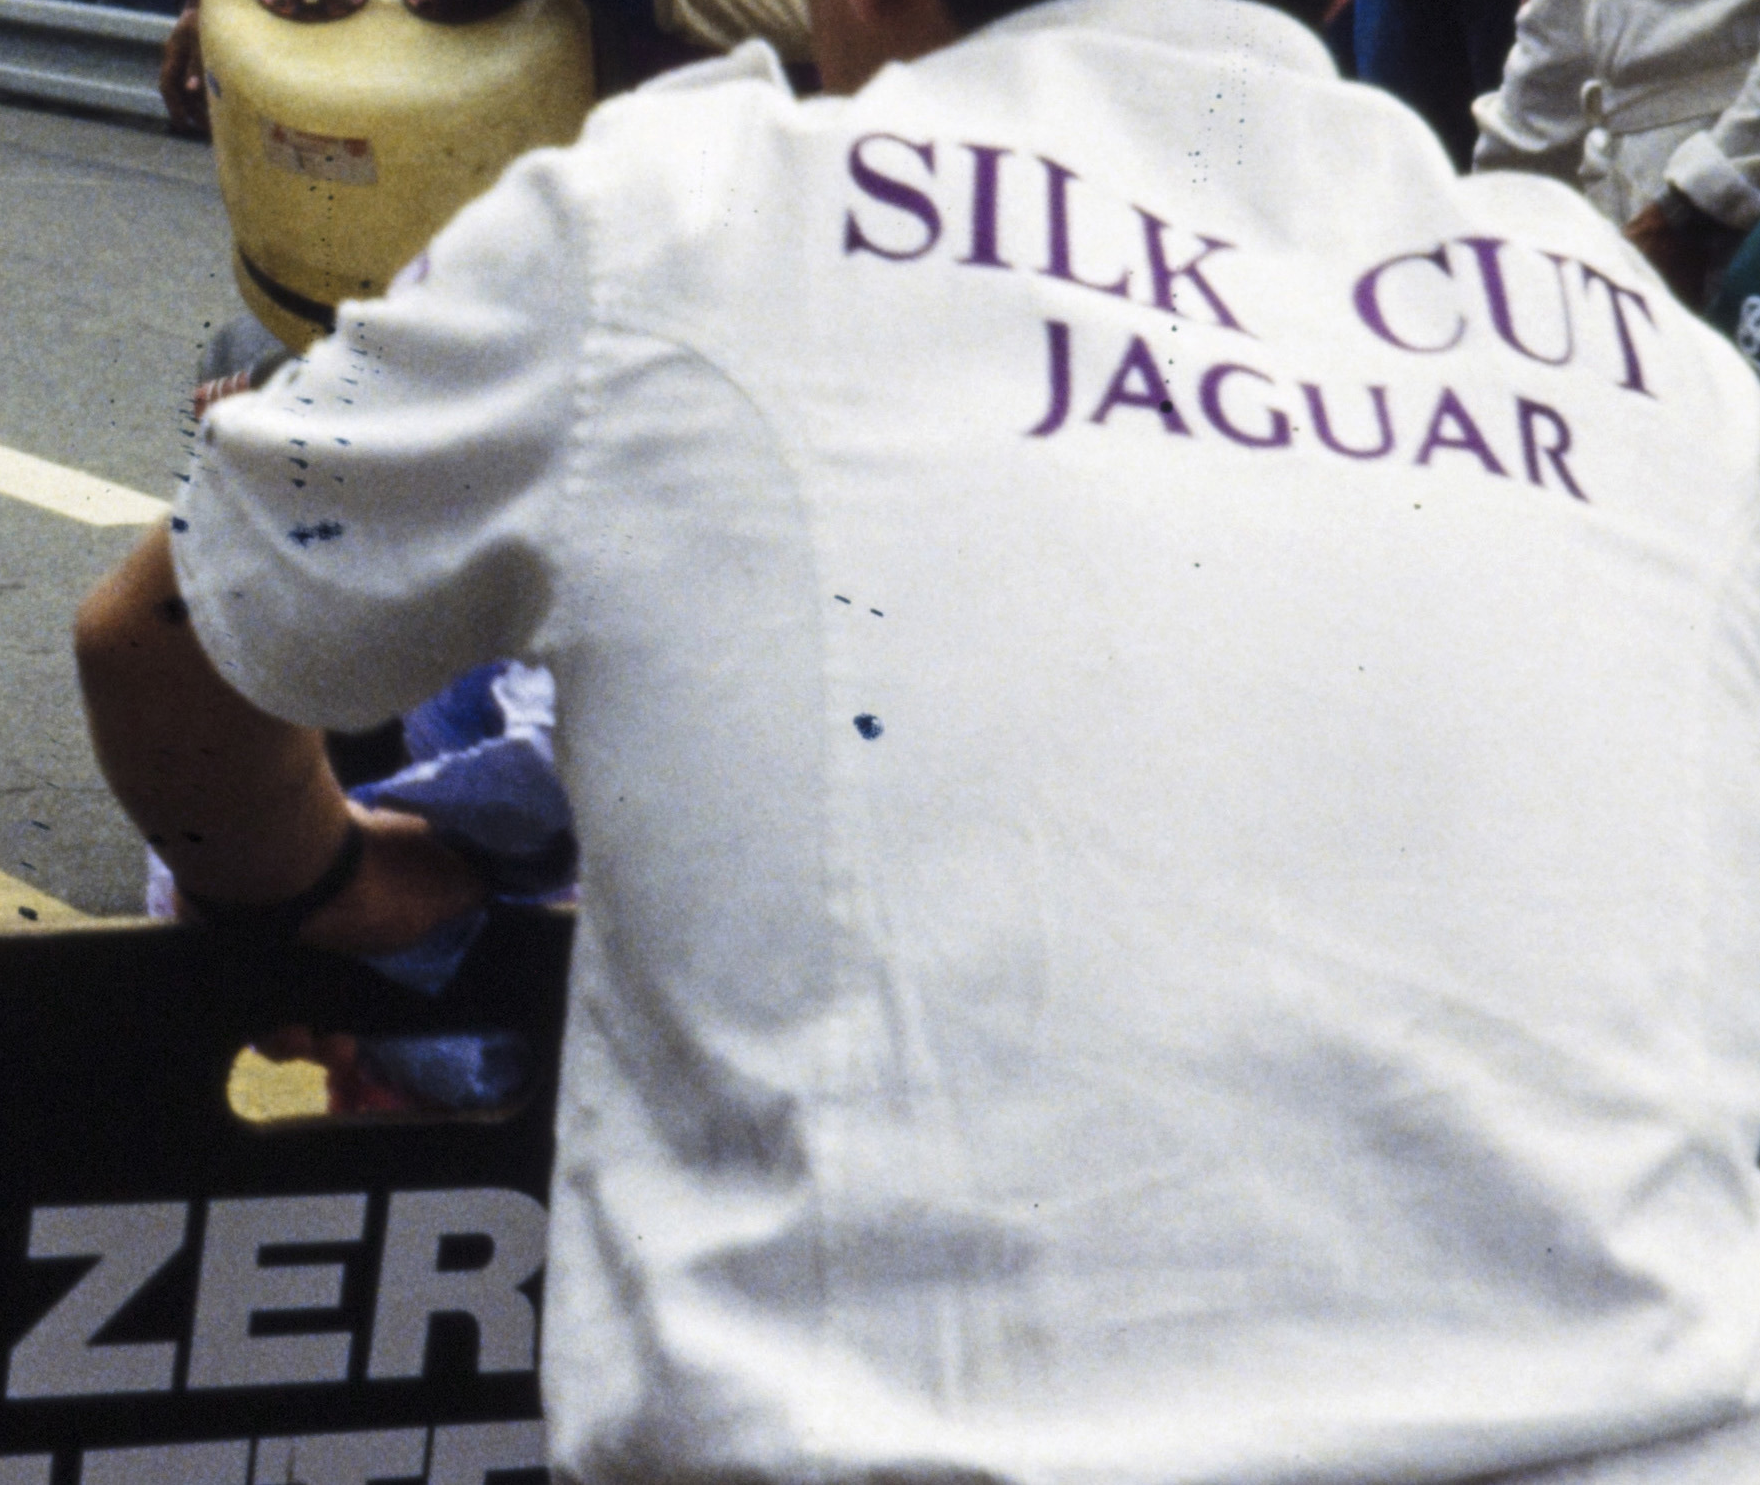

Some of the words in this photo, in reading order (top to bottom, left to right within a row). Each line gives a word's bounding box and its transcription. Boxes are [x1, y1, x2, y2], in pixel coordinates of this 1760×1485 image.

[842, 131, 1257, 337] SILK
[1350, 236, 1660, 398] CUT
[1026, 319, 1591, 504] JAGUAR
[3, 1187, 552, 1400] ZER
